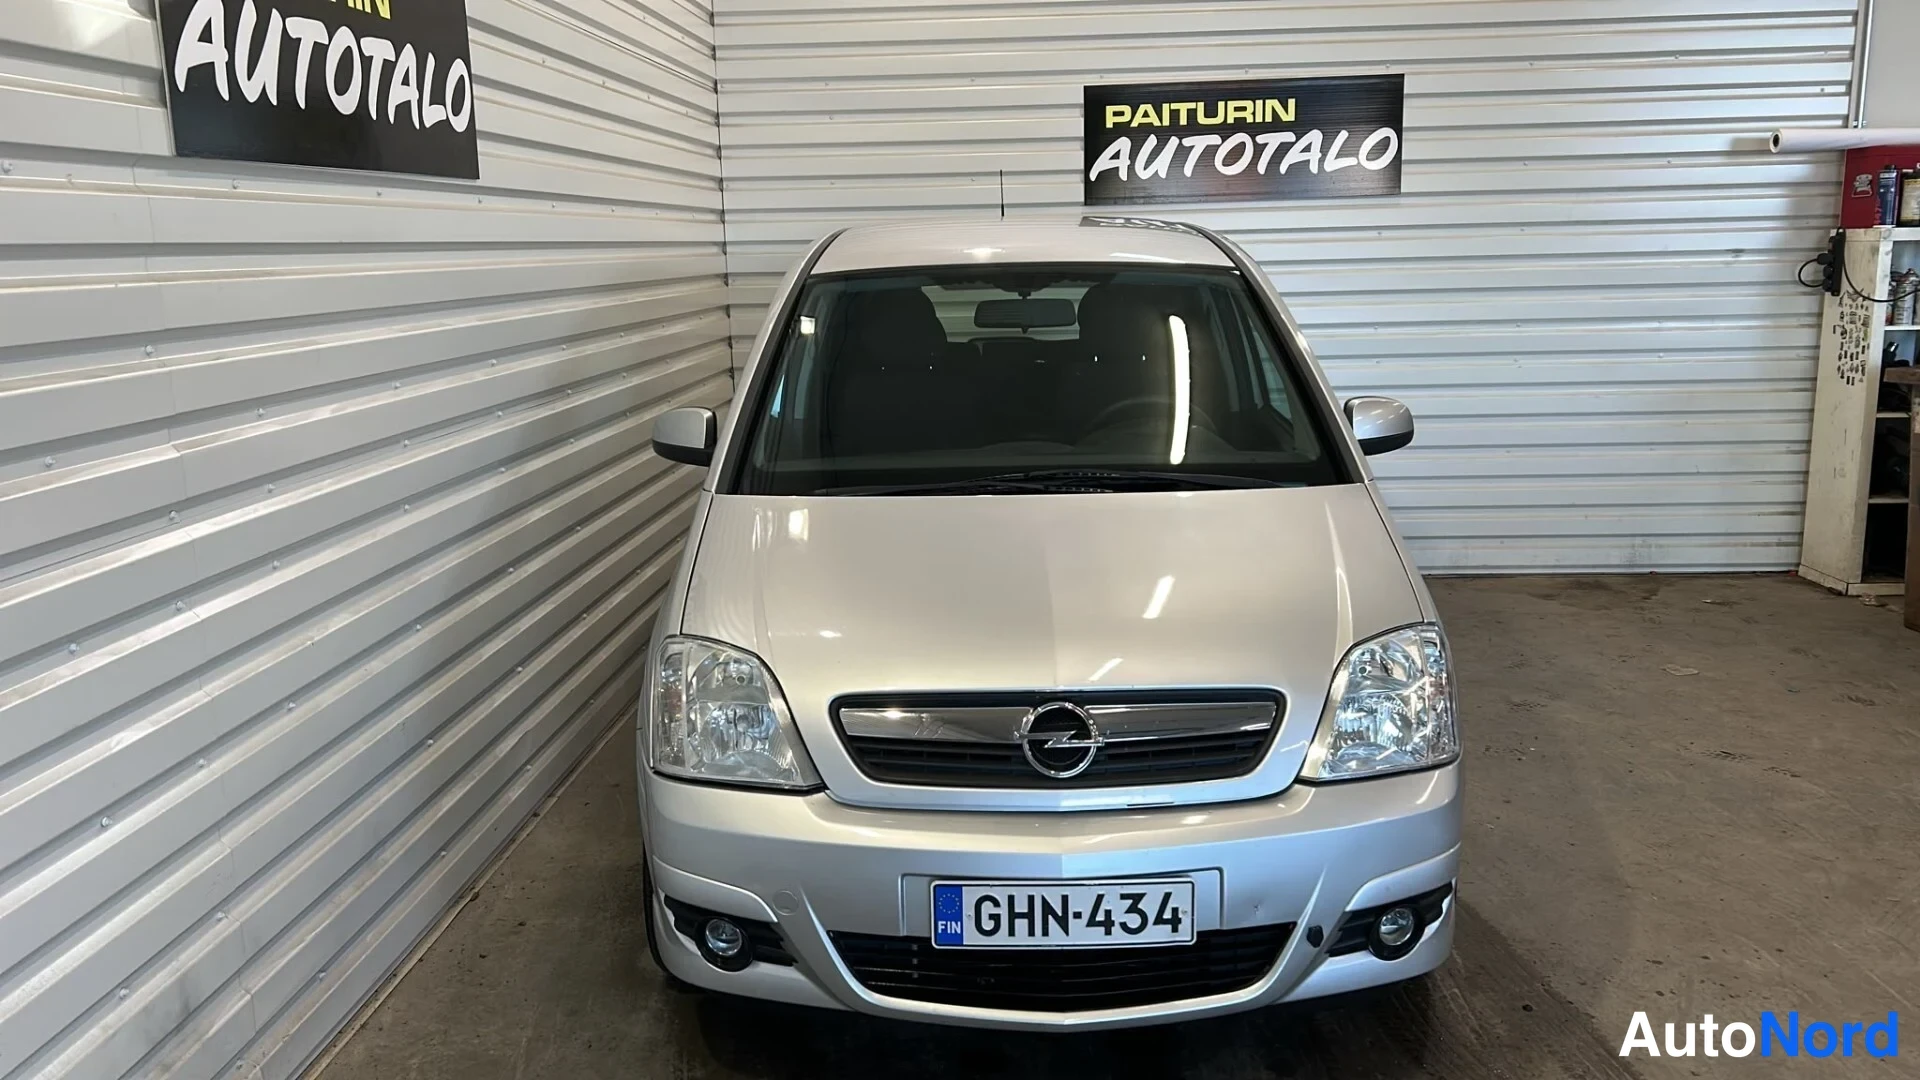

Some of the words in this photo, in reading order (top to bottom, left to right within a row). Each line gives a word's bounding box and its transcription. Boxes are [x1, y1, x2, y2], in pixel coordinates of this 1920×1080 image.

[174, 0, 471, 132] AUTOTALO
[1105, 98, 1296, 128] PAITURIN
[1089, 127, 1399, 182] AUTOTALO
[938, 920, 961, 934] FIN
[974, 892, 1182, 937] GHN-434
